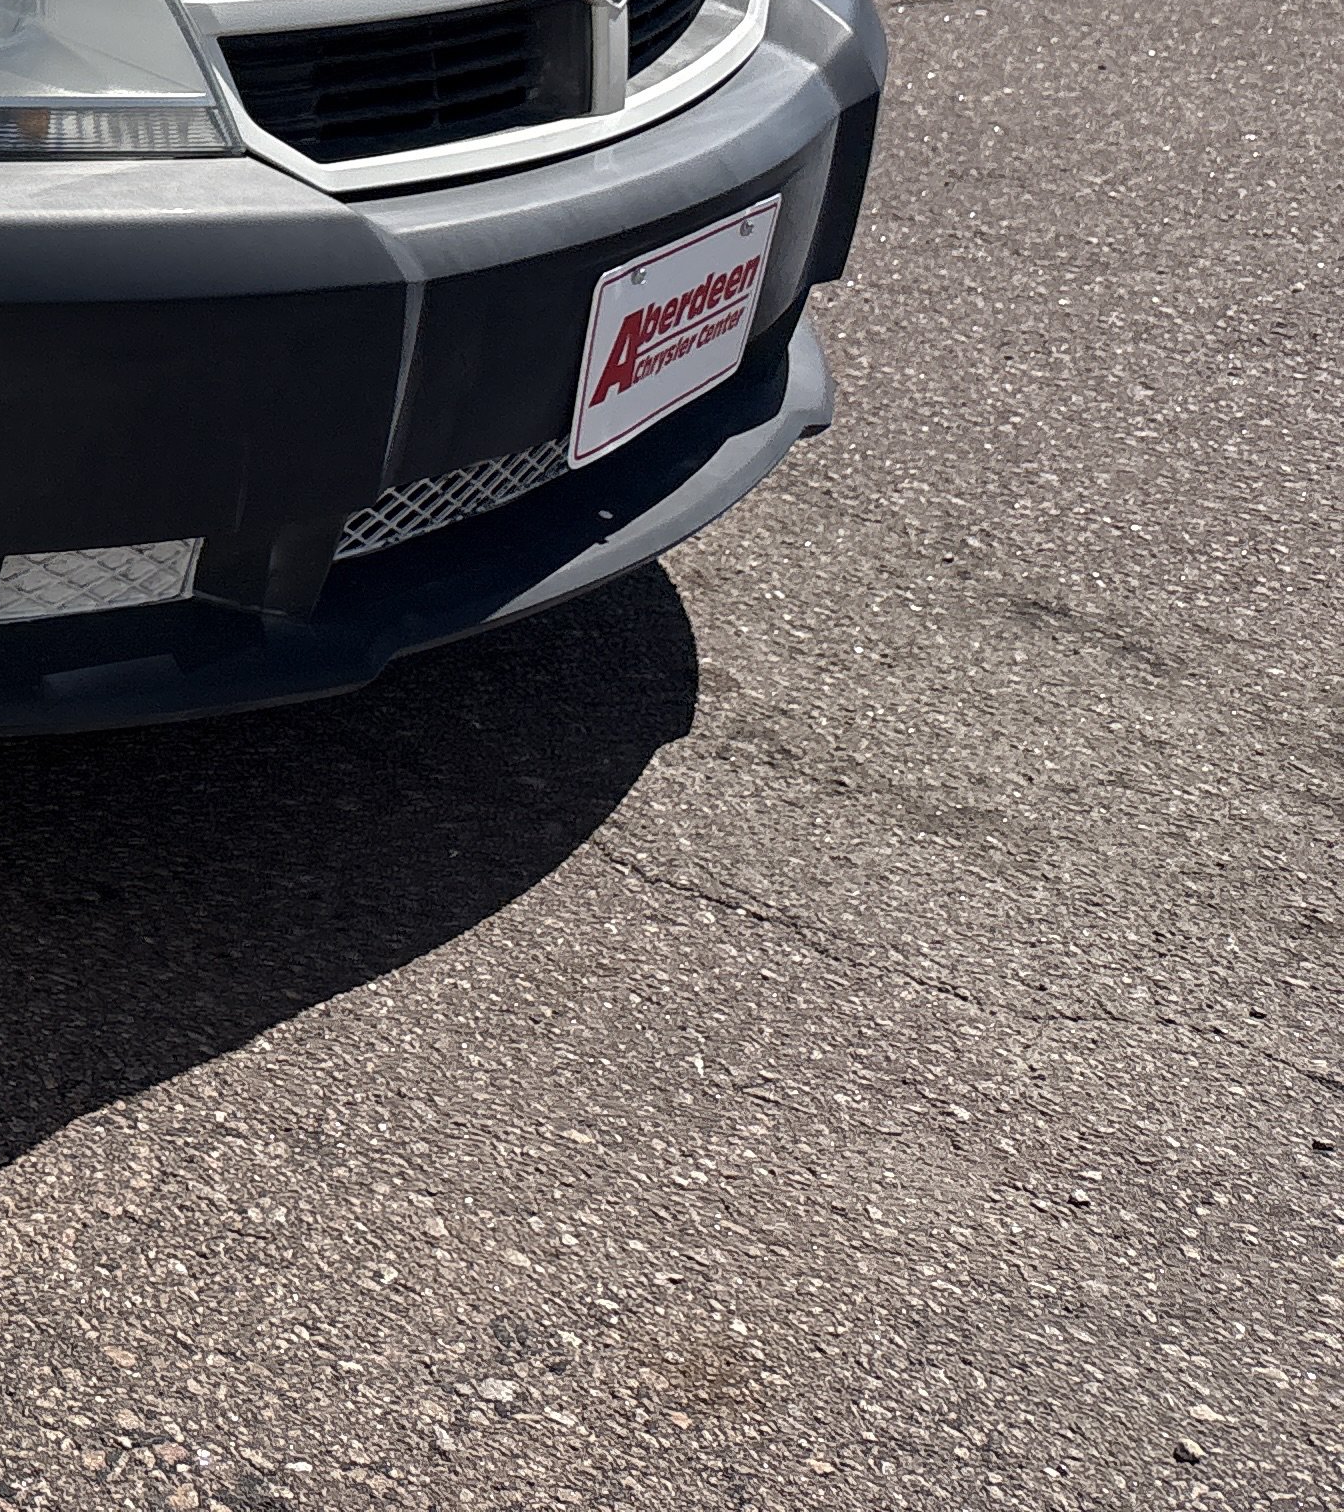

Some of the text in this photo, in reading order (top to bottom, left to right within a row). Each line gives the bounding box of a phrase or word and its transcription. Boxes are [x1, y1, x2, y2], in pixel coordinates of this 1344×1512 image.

[588, 255, 761, 408] Aberdeen
[633, 307, 746, 384] Chrysler Center
